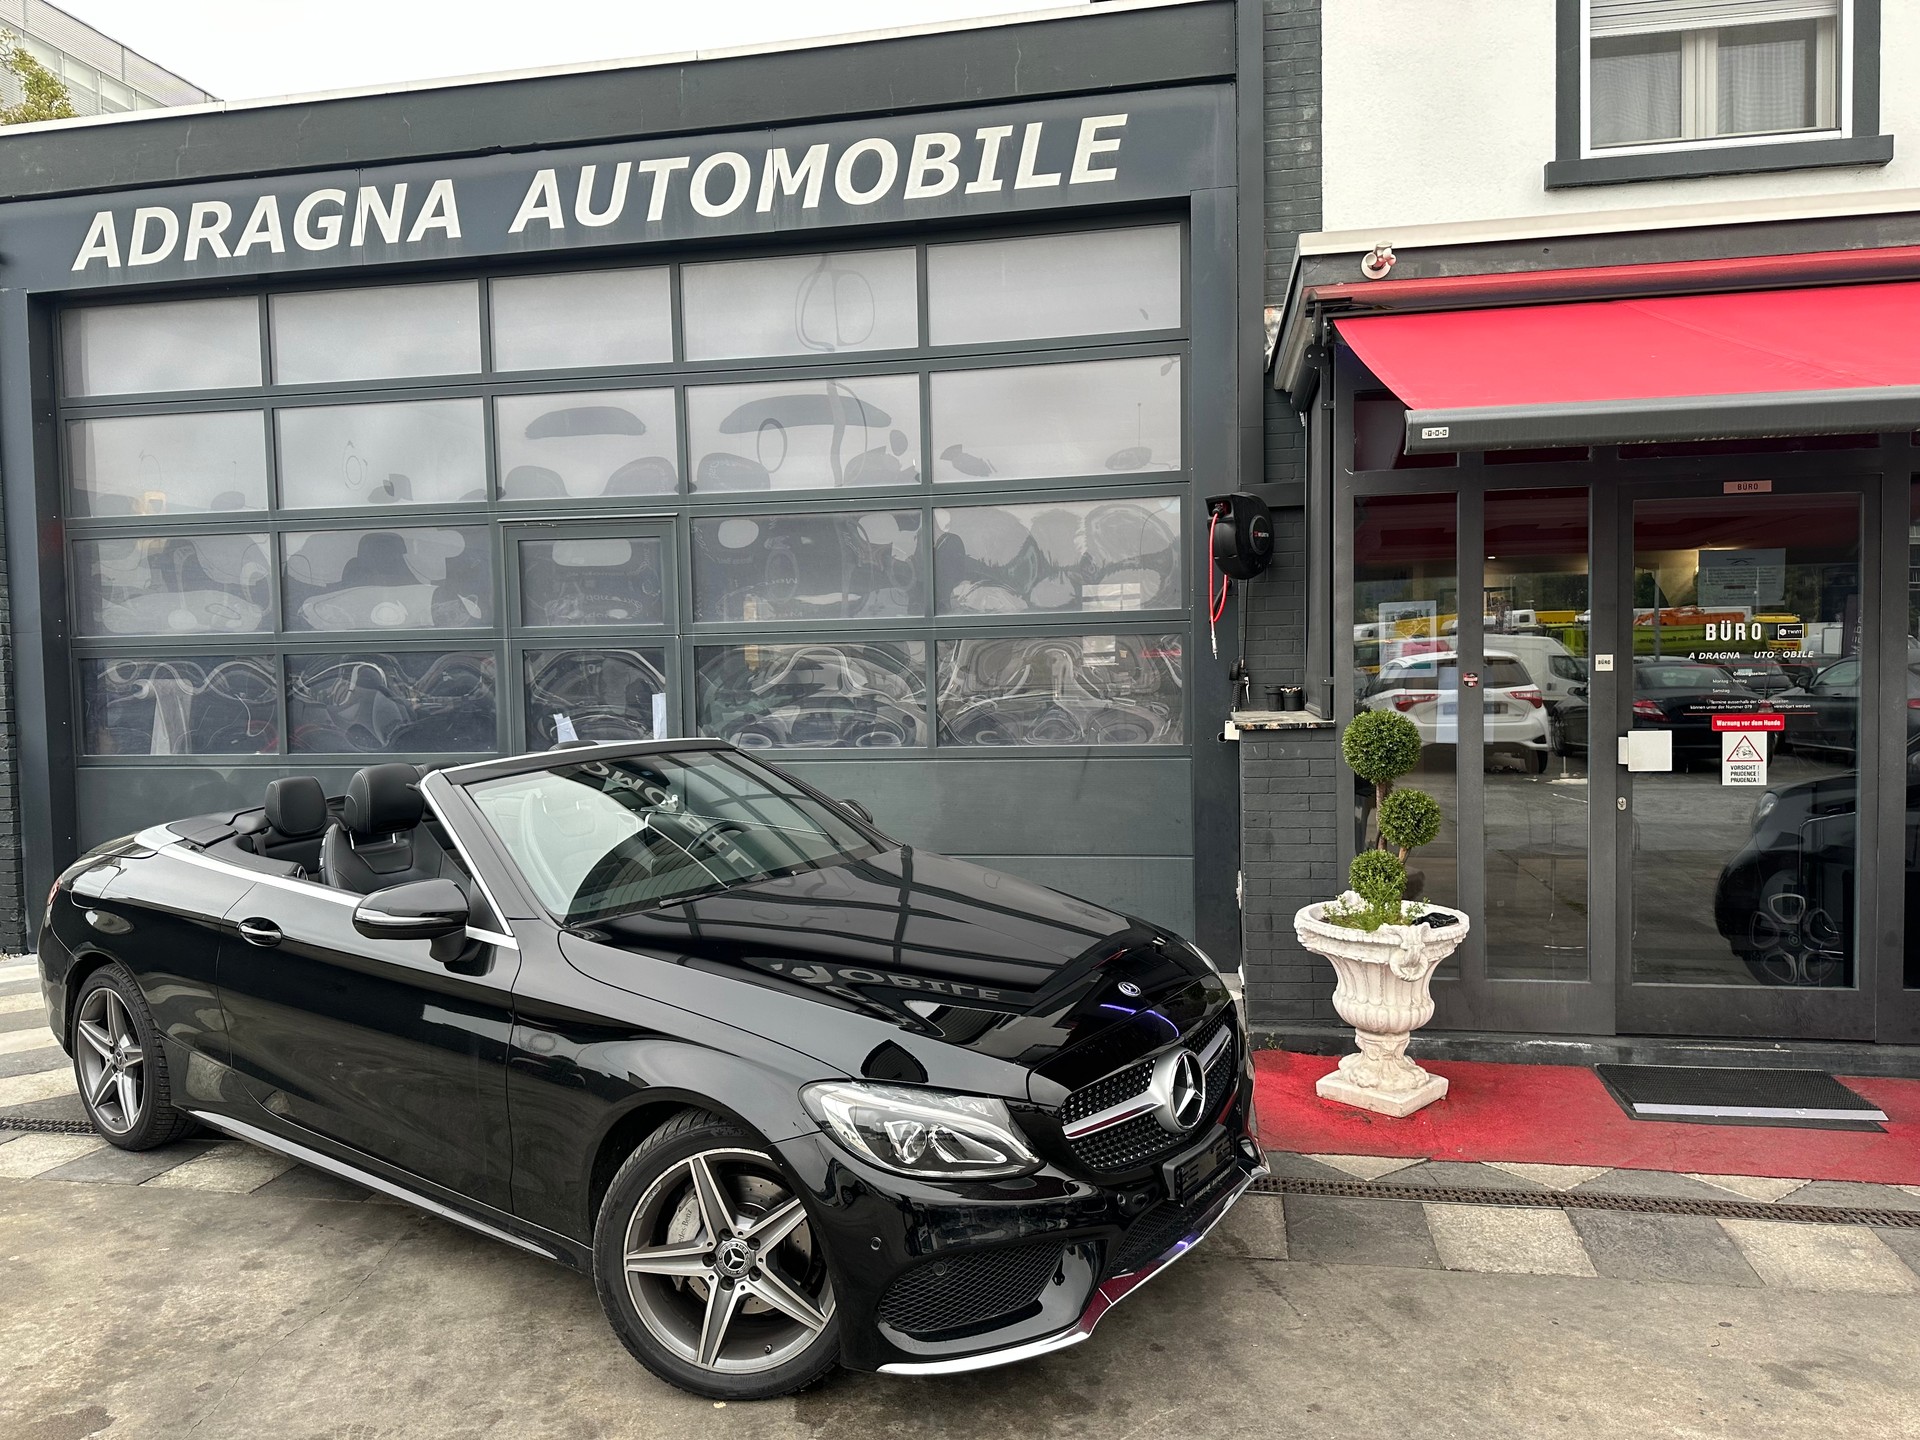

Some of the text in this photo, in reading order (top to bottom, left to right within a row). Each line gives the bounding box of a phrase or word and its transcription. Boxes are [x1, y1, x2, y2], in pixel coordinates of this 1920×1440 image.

[71, 113, 1128, 271] ADRAGNA AUTOMOBILE
[1705, 620, 1762, 641] BÜRO
[1716, 719, 1740, 728] Warnung
[1751, 719, 1763, 727] dem
[1763, 719, 1781, 727] Hunde
